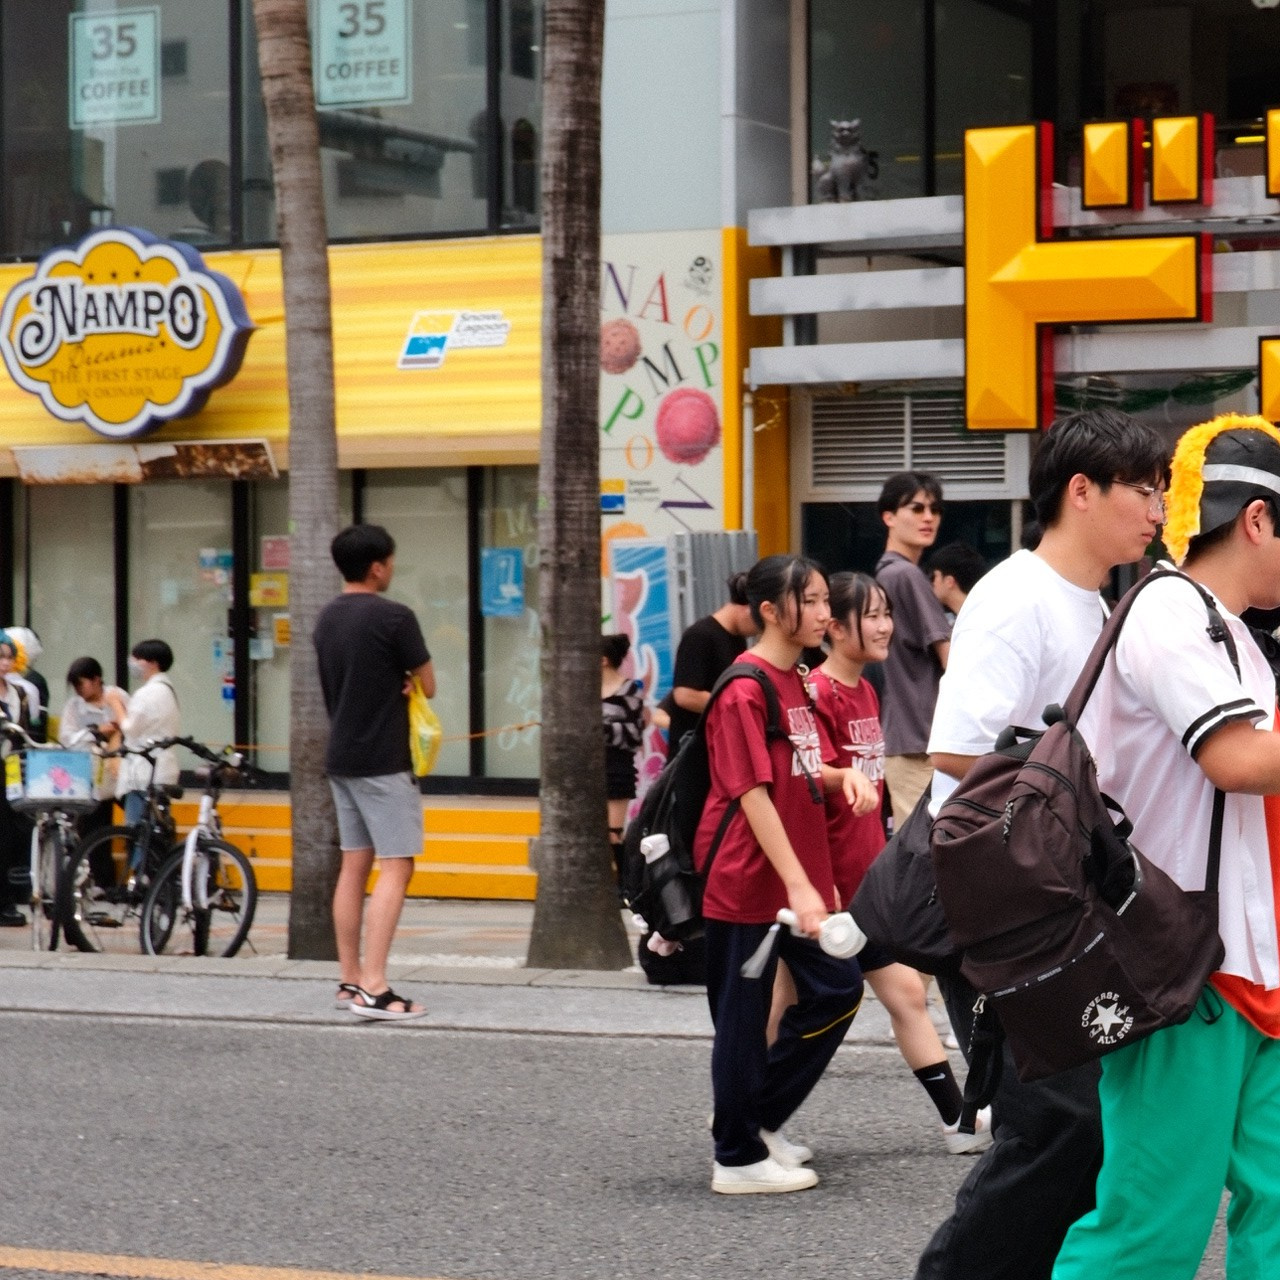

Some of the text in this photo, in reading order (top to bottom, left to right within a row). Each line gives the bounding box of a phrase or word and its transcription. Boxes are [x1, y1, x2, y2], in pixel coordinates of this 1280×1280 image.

[338, 0, 387, 38] 35
[91, 23, 138, 61] 35
[325, 59, 400, 80] COFFEE
[80, 80, 150, 100] COFFEE
[20, 283, 199, 360] NAMPO
[1081, 991, 1120, 1028] CONVERSE
[1097, 1035, 1118, 1045] ALL
[1116, 1016, 1134, 1040] STAR
